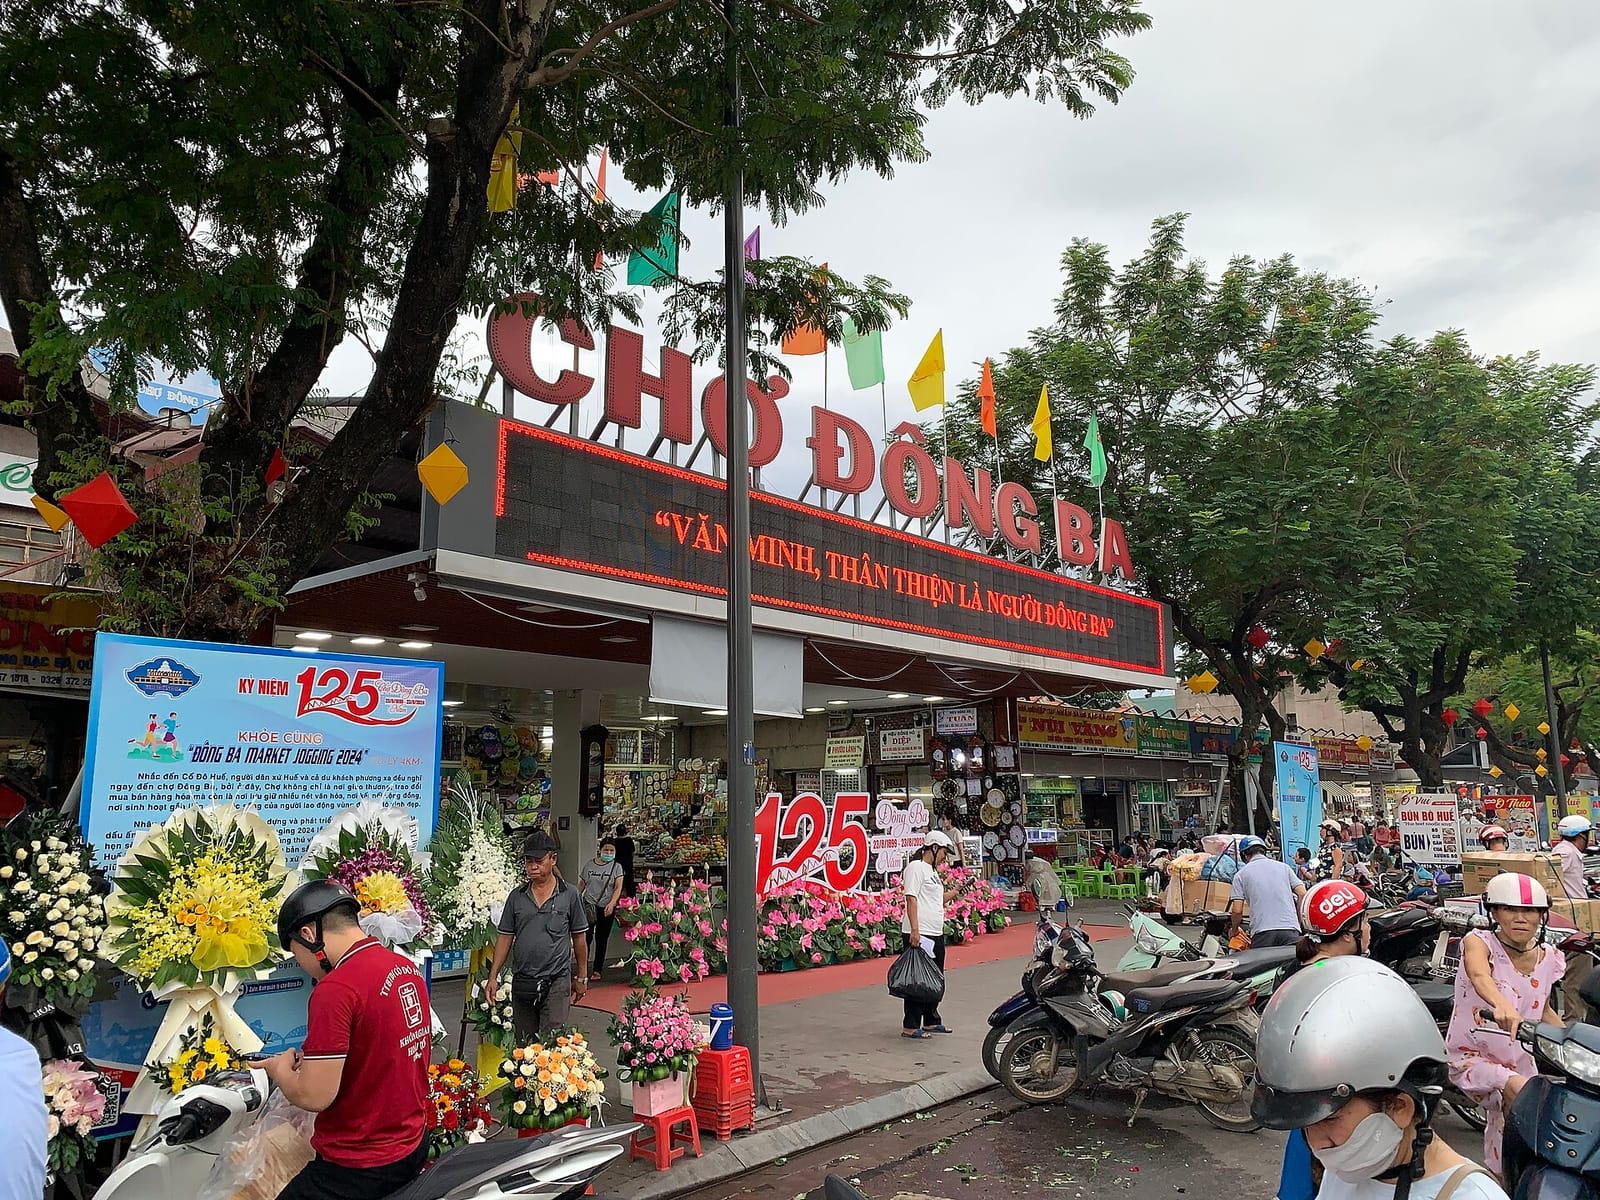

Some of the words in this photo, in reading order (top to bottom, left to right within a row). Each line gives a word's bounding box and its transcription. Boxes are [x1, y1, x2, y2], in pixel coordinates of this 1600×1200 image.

[487, 292, 790, 488] CHỢ
[806, 405, 1041, 555] ĐÔNG
[1054, 495, 1136, 580] BA
[825, 551, 889, 590] THÂN
[892, 567, 955, 608] THIỆN
[958, 581, 983, 612] LÀ
[986, 590, 1043, 623] NGƯỜI
[1045, 601, 1088, 632] ĐÔNG
[258, 677, 289, 697] NIỆM
[296, 667, 382, 717] 125
[238, 728, 279, 743] KHỎE
[283, 730, 323, 744] CÙNG
[225, 746, 242, 762] BA
[244, 747, 292, 764] MARKET
[293, 749, 333, 764] JOGGING
[138, 772, 161, 781] Nhắc
[163, 772, 179, 781] đến
[182, 772, 194, 780] Cố
[196, 772, 208, 780] Đô
[210, 772, 229, 781] Huế,
[283, 772, 299, 781] Huế
[110, 784, 133, 793] ngay
[137, 782, 153, 790] đến
[177, 783, 200, 792] Đông
[245, 783, 262, 791] đây,
[264, 783, 281, 791] Chợ
[283, 783, 307, 792] không
[150, 793, 172, 803] hàng
[278, 792, 300, 800] nhiều
[330, 793, 345, 801] hóa,
[108, 803, 122, 811] nơi
[148, 803, 167, 812] hoạt
[316, 802, 335, 811] động
[909, 801, 928, 824] Ba
[1401, 809, 1419, 821] BÚN
[1422, 809, 1434, 821] BÒ
[1437, 807, 1455, 821] HUẾ
[267, 818, 287, 827] dựng
[300, 817, 317, 826] phát
[105, 831, 123, 839] dấu
[1403, 832, 1426, 850] BÚN
[104, 843, 122, 851] hẹn
[755, 796, 869, 899] 125
